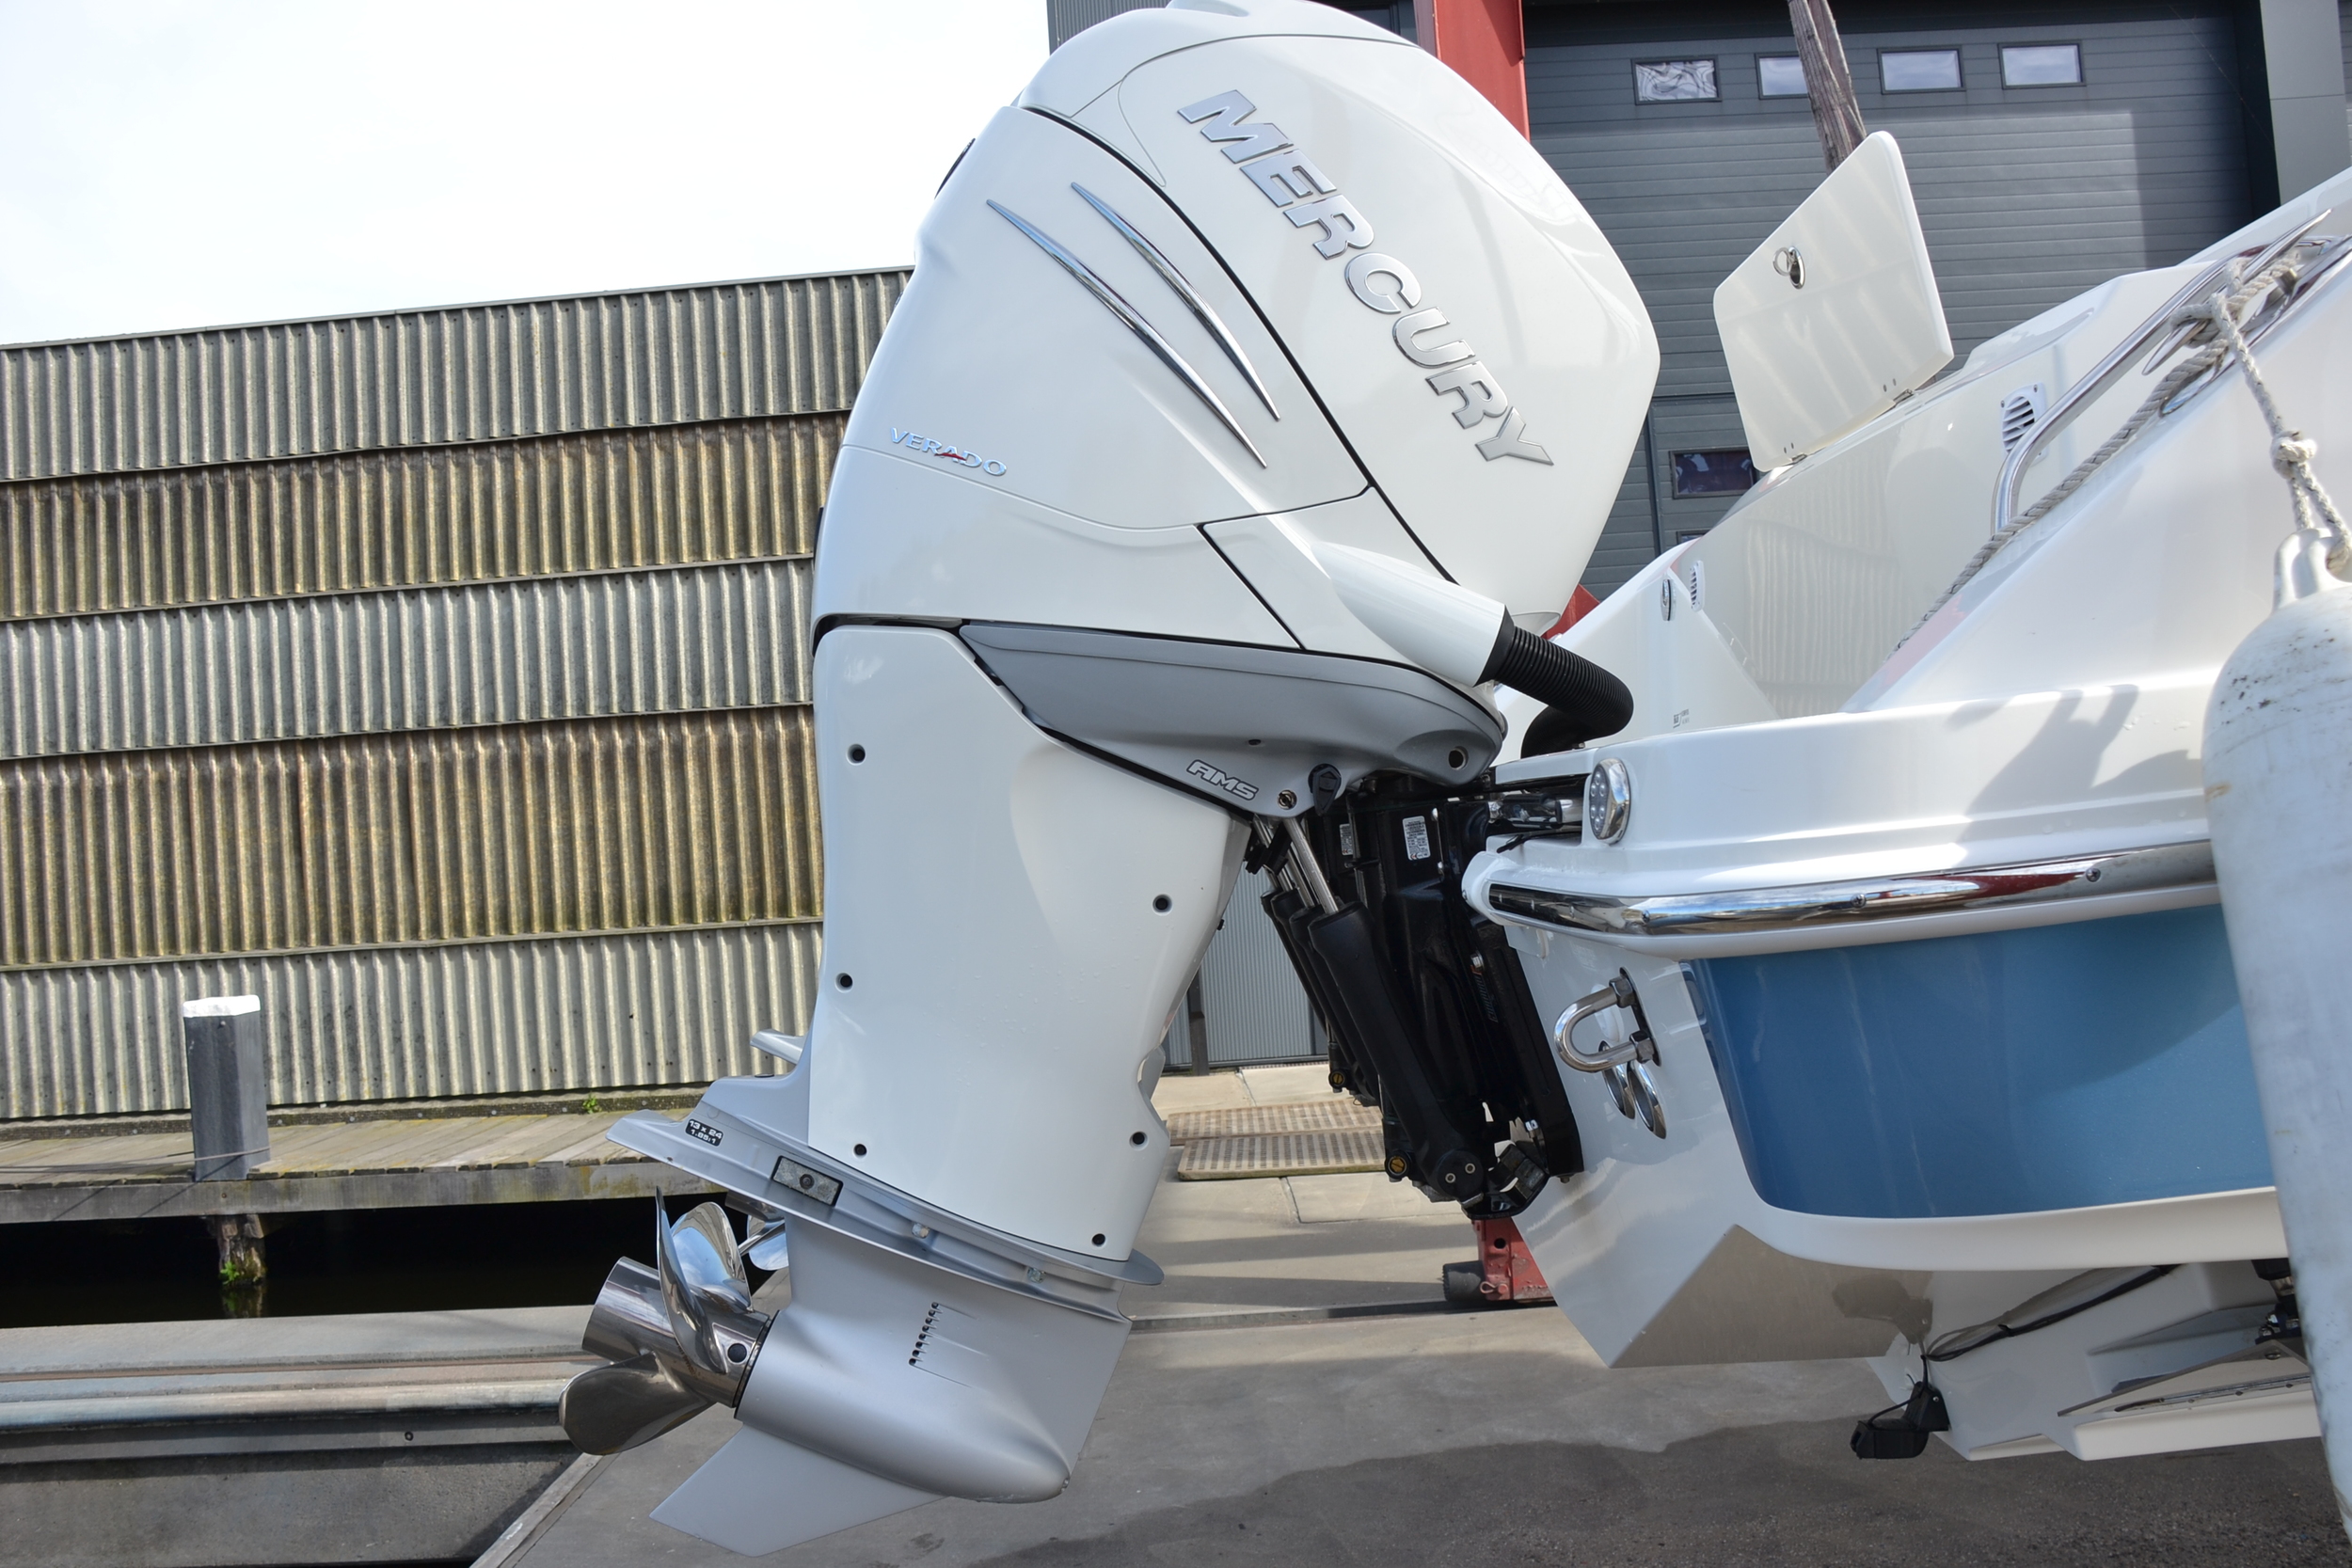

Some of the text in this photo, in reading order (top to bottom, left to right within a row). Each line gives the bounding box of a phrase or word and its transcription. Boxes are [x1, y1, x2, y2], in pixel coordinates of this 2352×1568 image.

[1177, 89, 1554, 466] MERCURY
[890, 427, 1007, 476] VERADO
[1186, 759, 1259, 800] AMS
[689, 1120, 701, 1130] 13
[708, 1129, 723, 1139] 24
